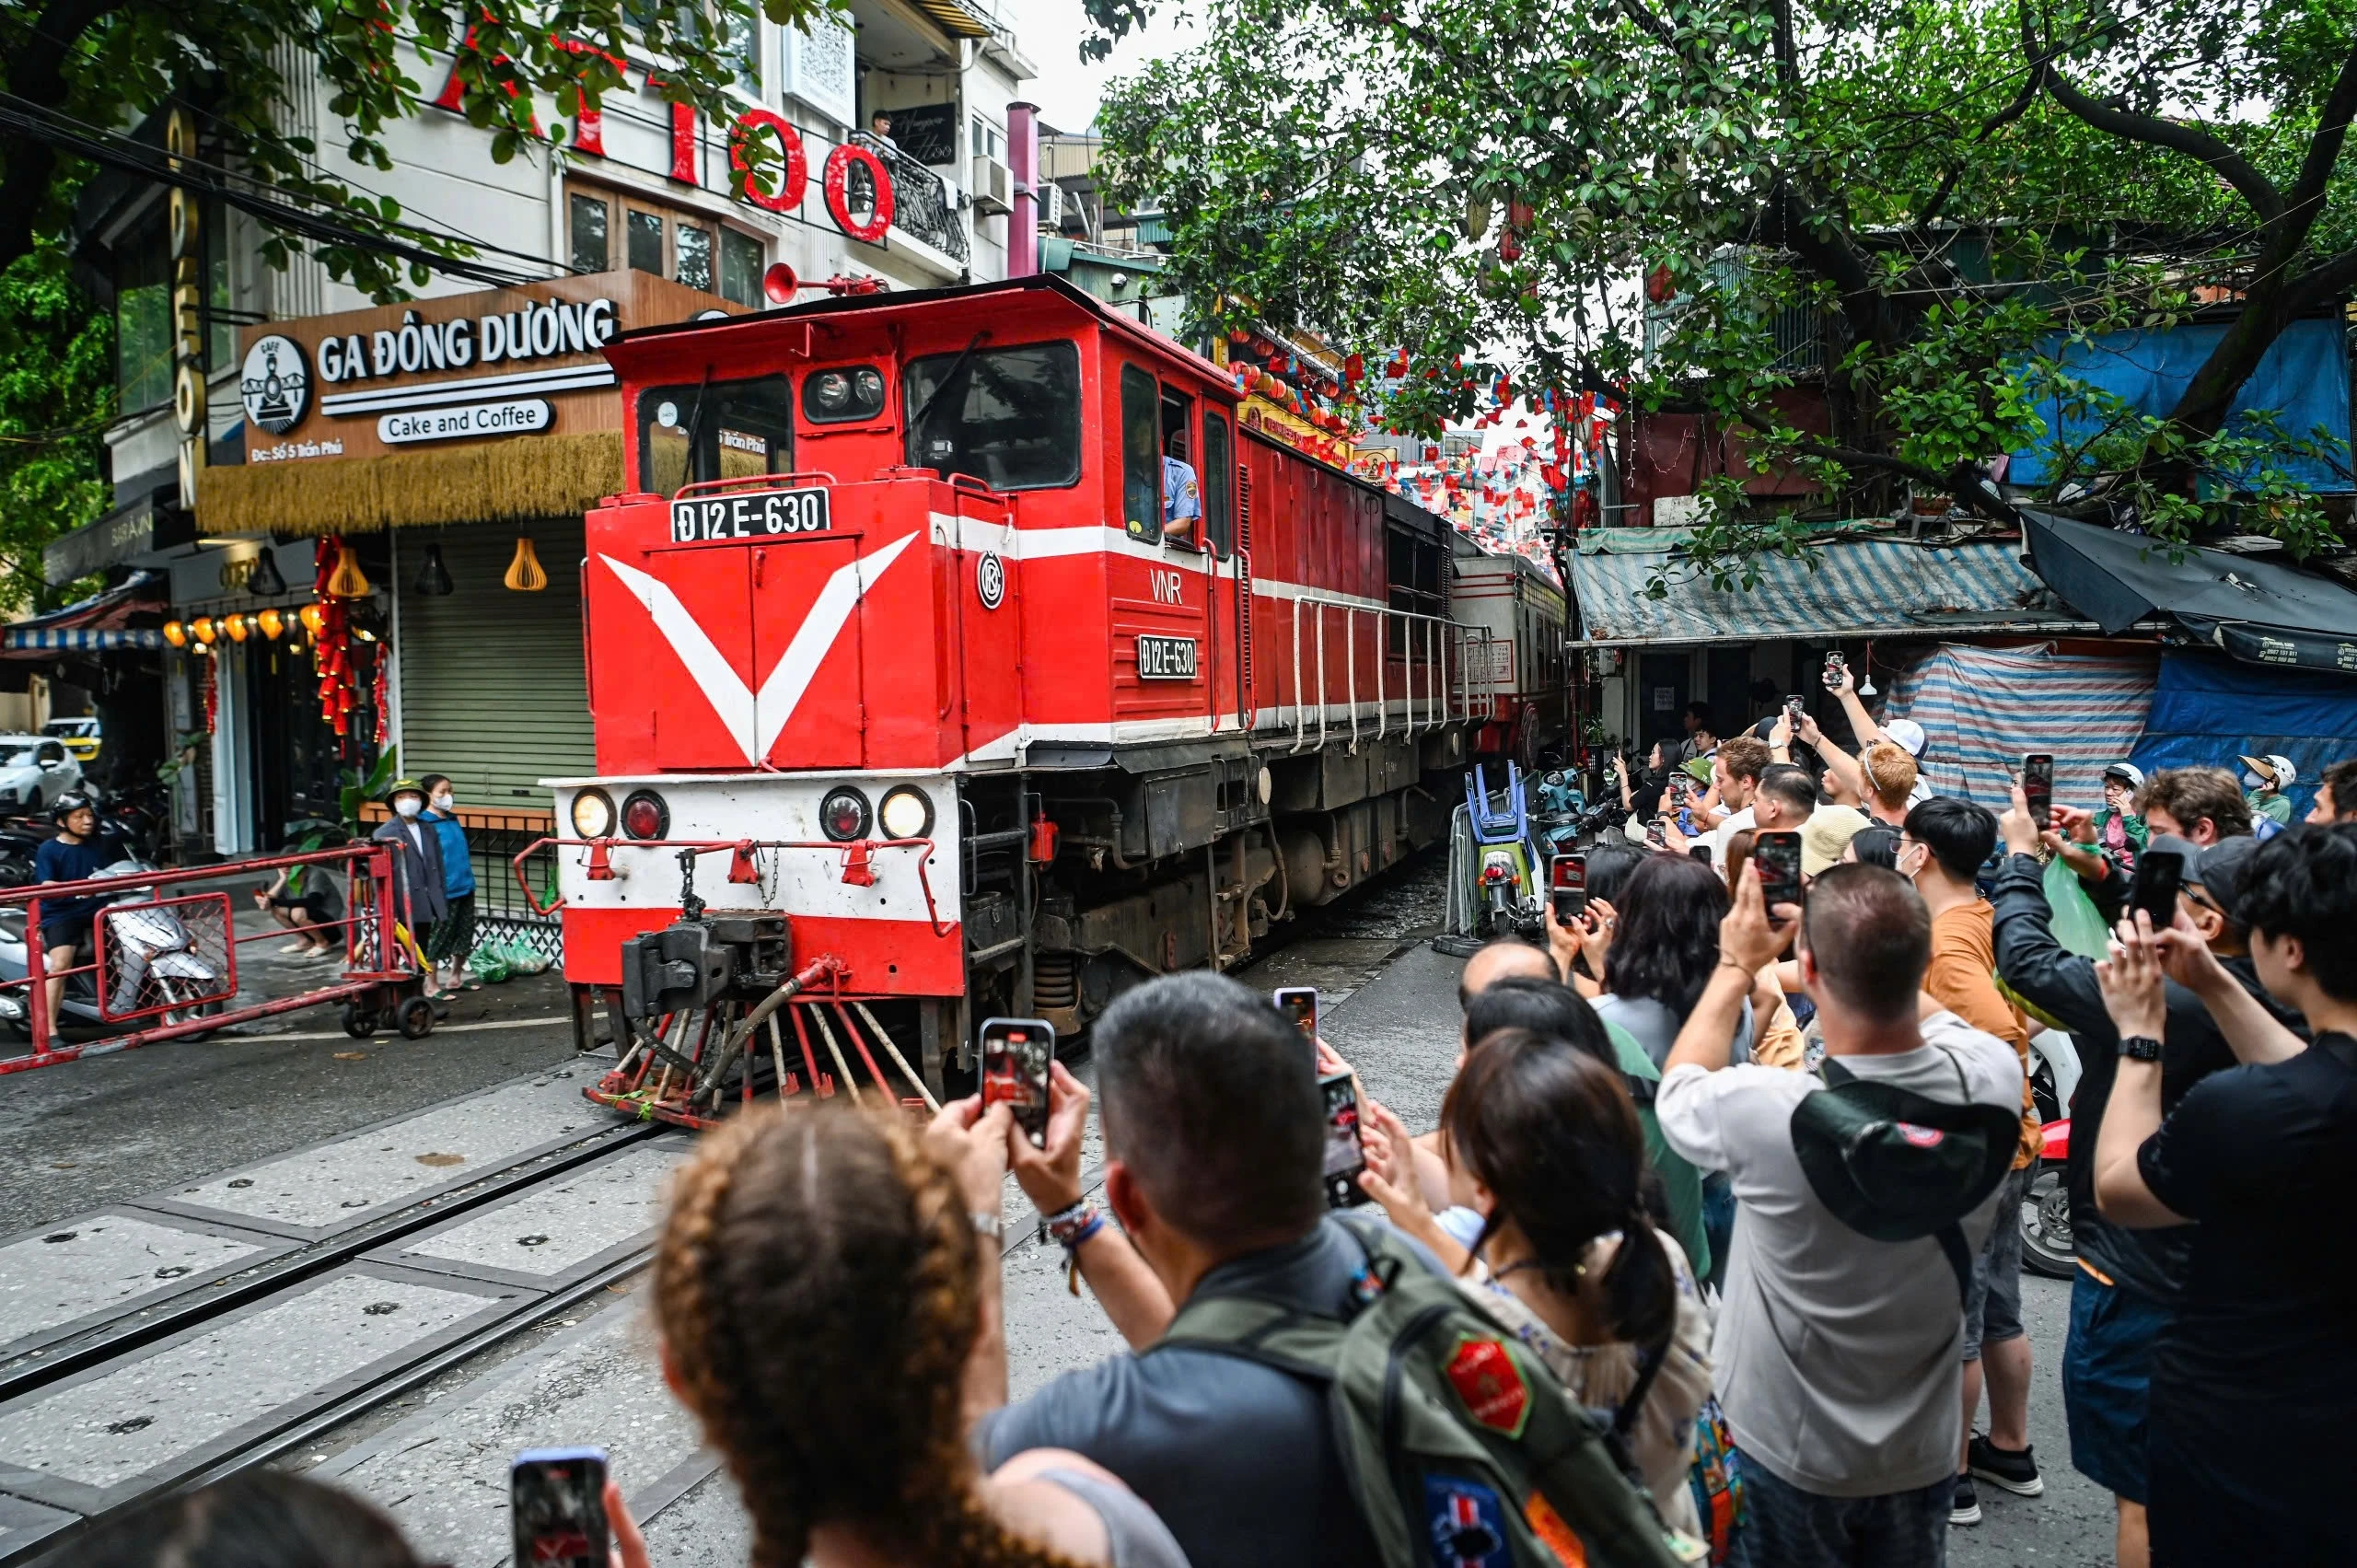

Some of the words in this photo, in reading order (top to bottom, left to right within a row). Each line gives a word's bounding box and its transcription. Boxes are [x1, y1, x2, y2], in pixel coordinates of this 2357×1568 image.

[261, 342, 280, 354] CAFE
[317, 335, 367, 382] GA
[373, 309, 472, 376] ĐÔNG
[481, 296, 613, 362] DƯƠNG
[389, 418, 432, 437] Cake
[437, 412, 470, 433] and
[476, 406, 536, 428] Coffee
[288, 445, 296, 459] 5
[746, 437, 766, 454] Phú
[1150, 568, 1182, 605] VNR
